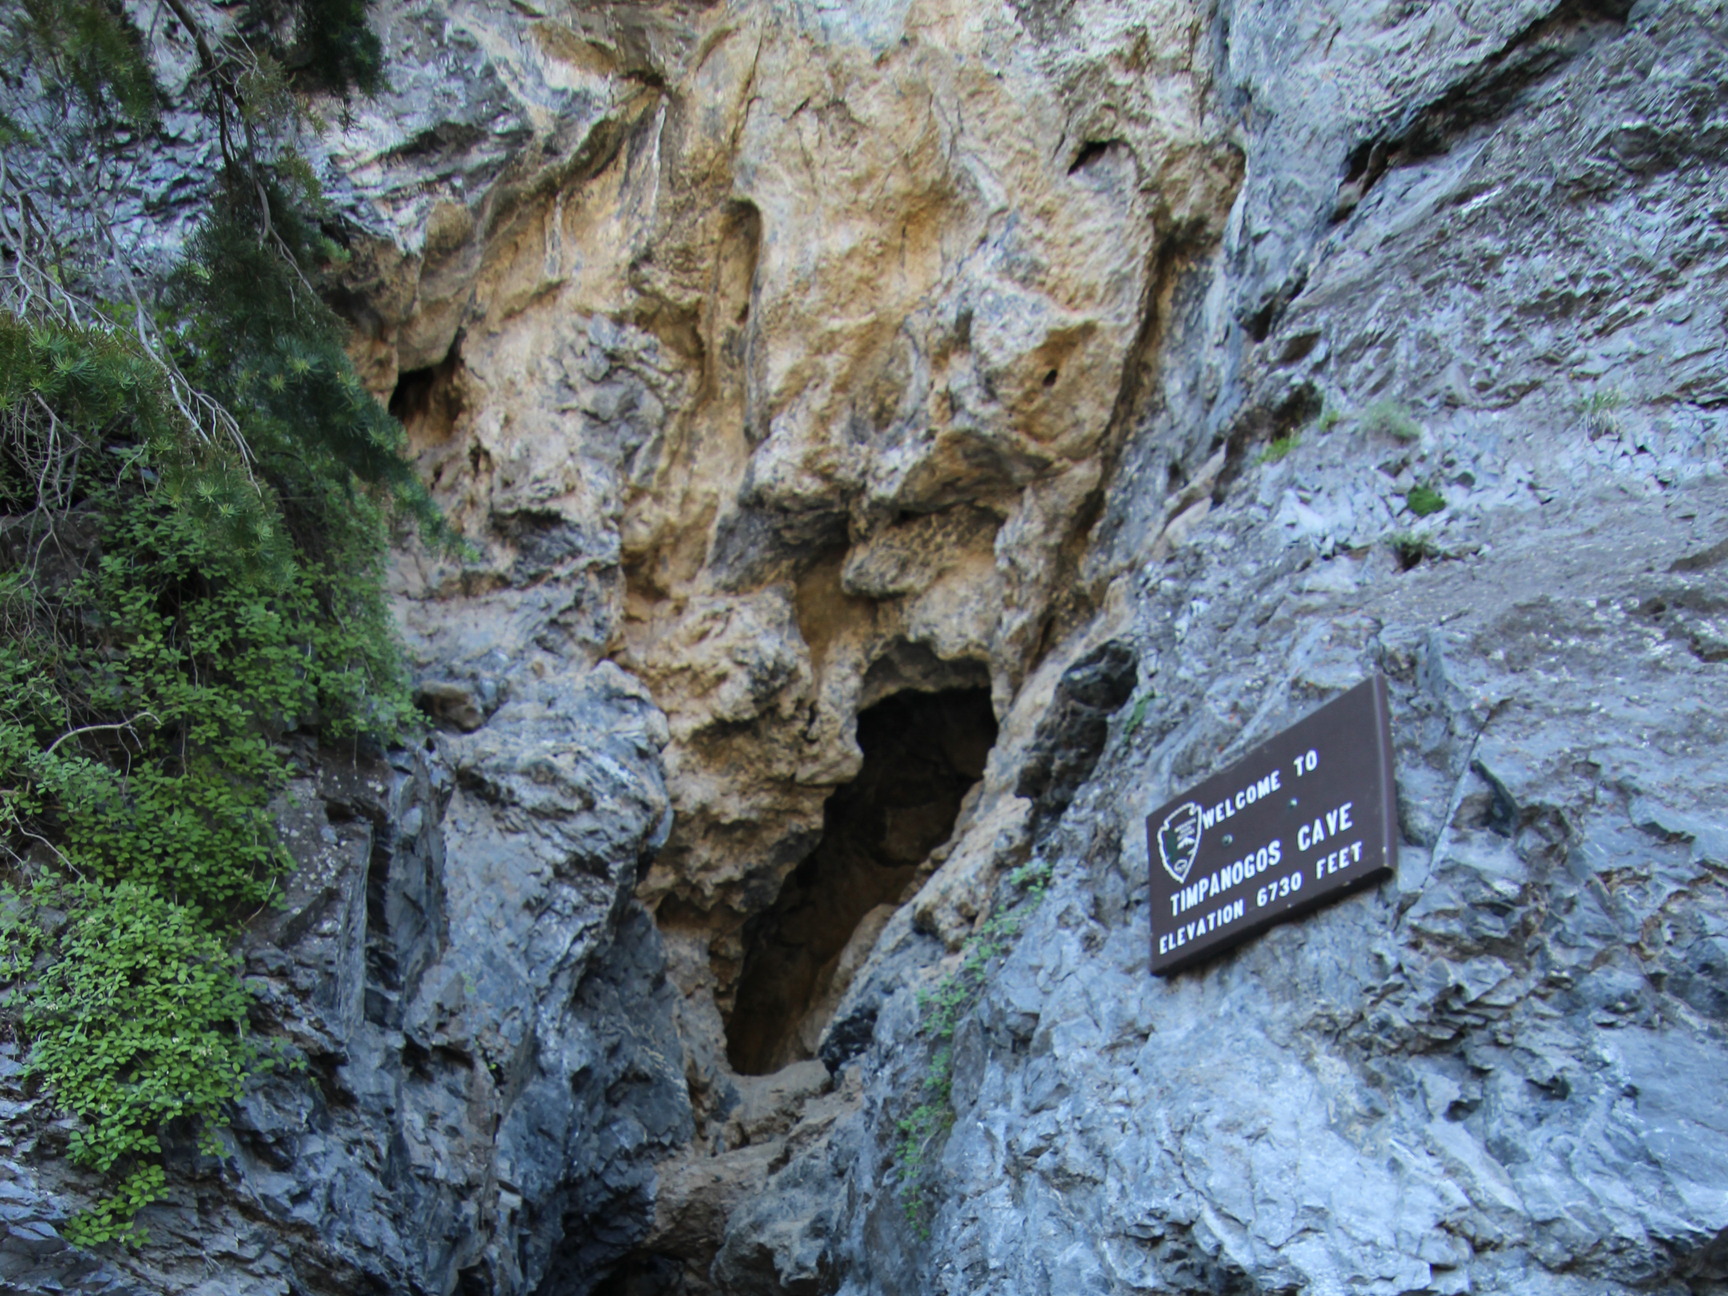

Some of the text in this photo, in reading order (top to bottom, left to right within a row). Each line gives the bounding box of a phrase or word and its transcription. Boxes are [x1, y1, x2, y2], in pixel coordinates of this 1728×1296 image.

[1202, 770, 1281, 830] WELCOME
[1293, 750, 1317, 776] TO
[1159, 841, 1362, 955] ELEVATION 6730 FEET
[1170, 802, 1352, 916] TIMPANOGOS CAVE
